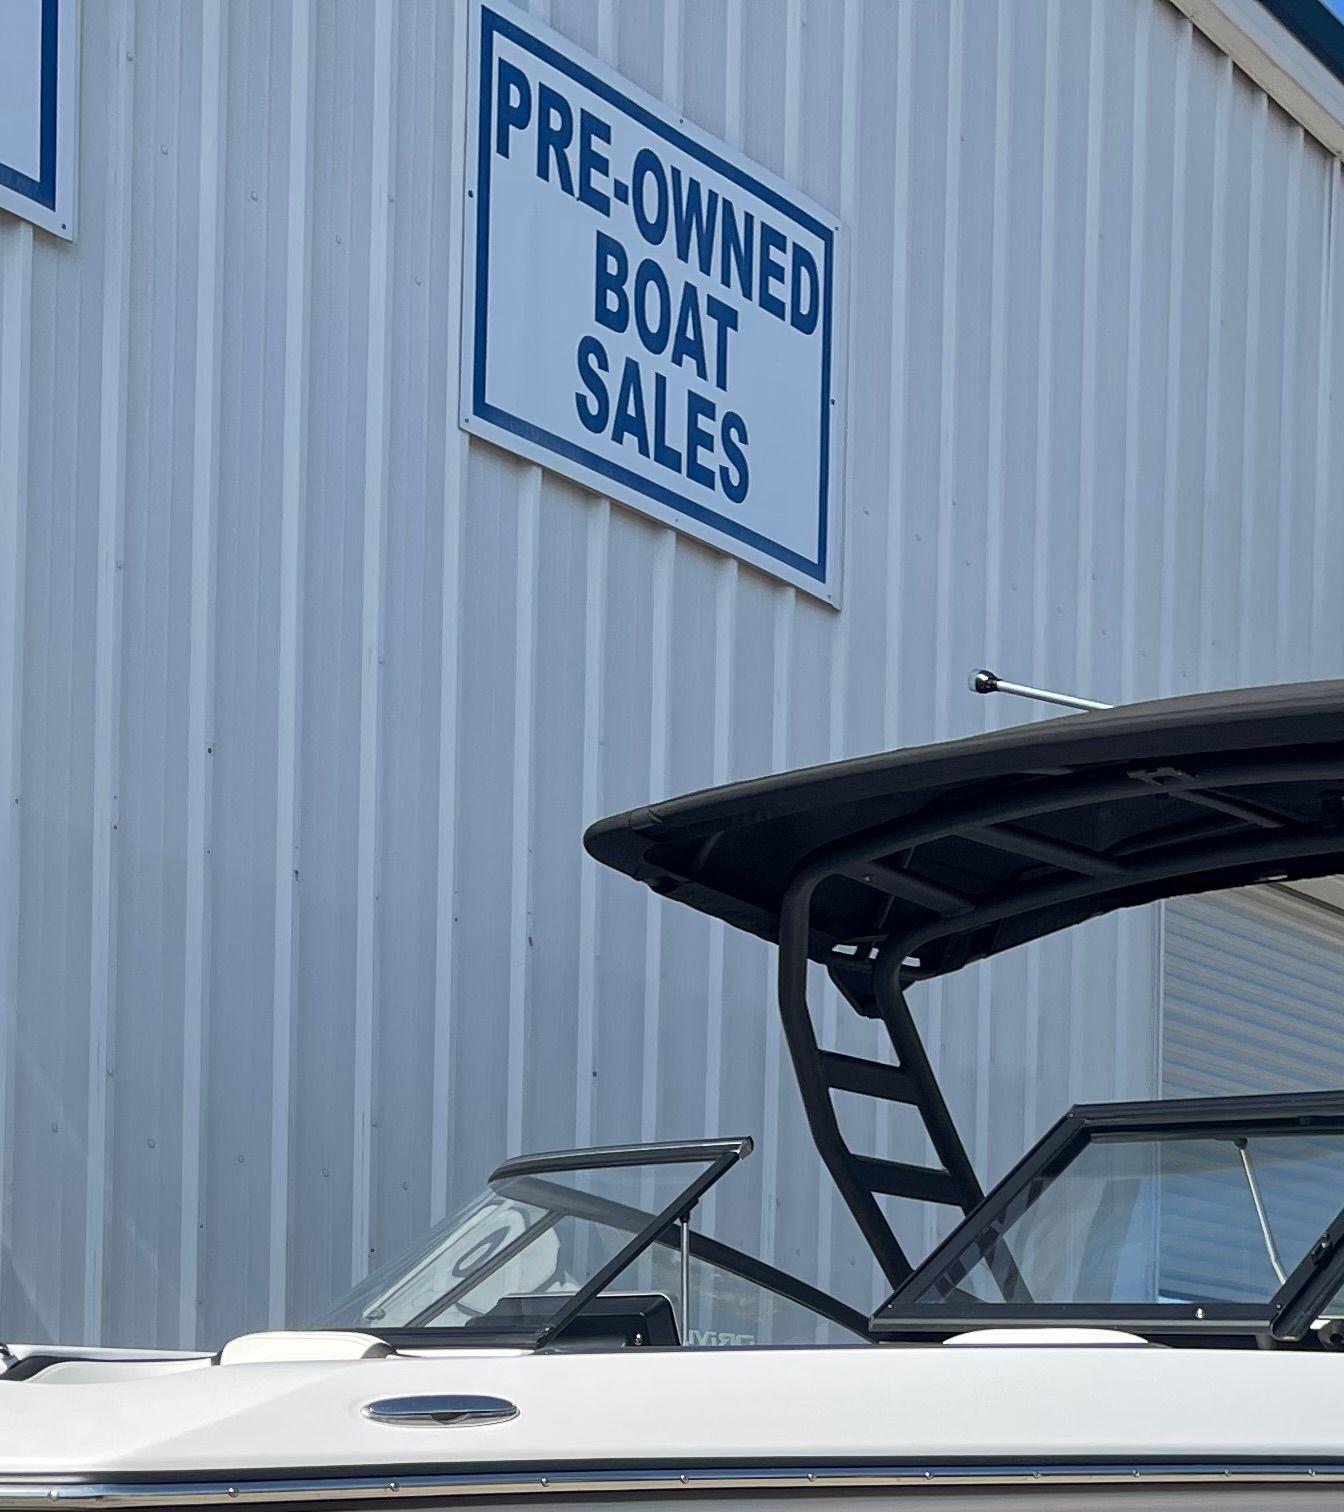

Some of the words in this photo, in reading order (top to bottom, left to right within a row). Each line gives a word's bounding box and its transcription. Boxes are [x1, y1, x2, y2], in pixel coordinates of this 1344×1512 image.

[496, 56, 820, 336] PRE-OWNED
[594, 229, 739, 392] BOAT
[574, 335, 750, 504] SALES
